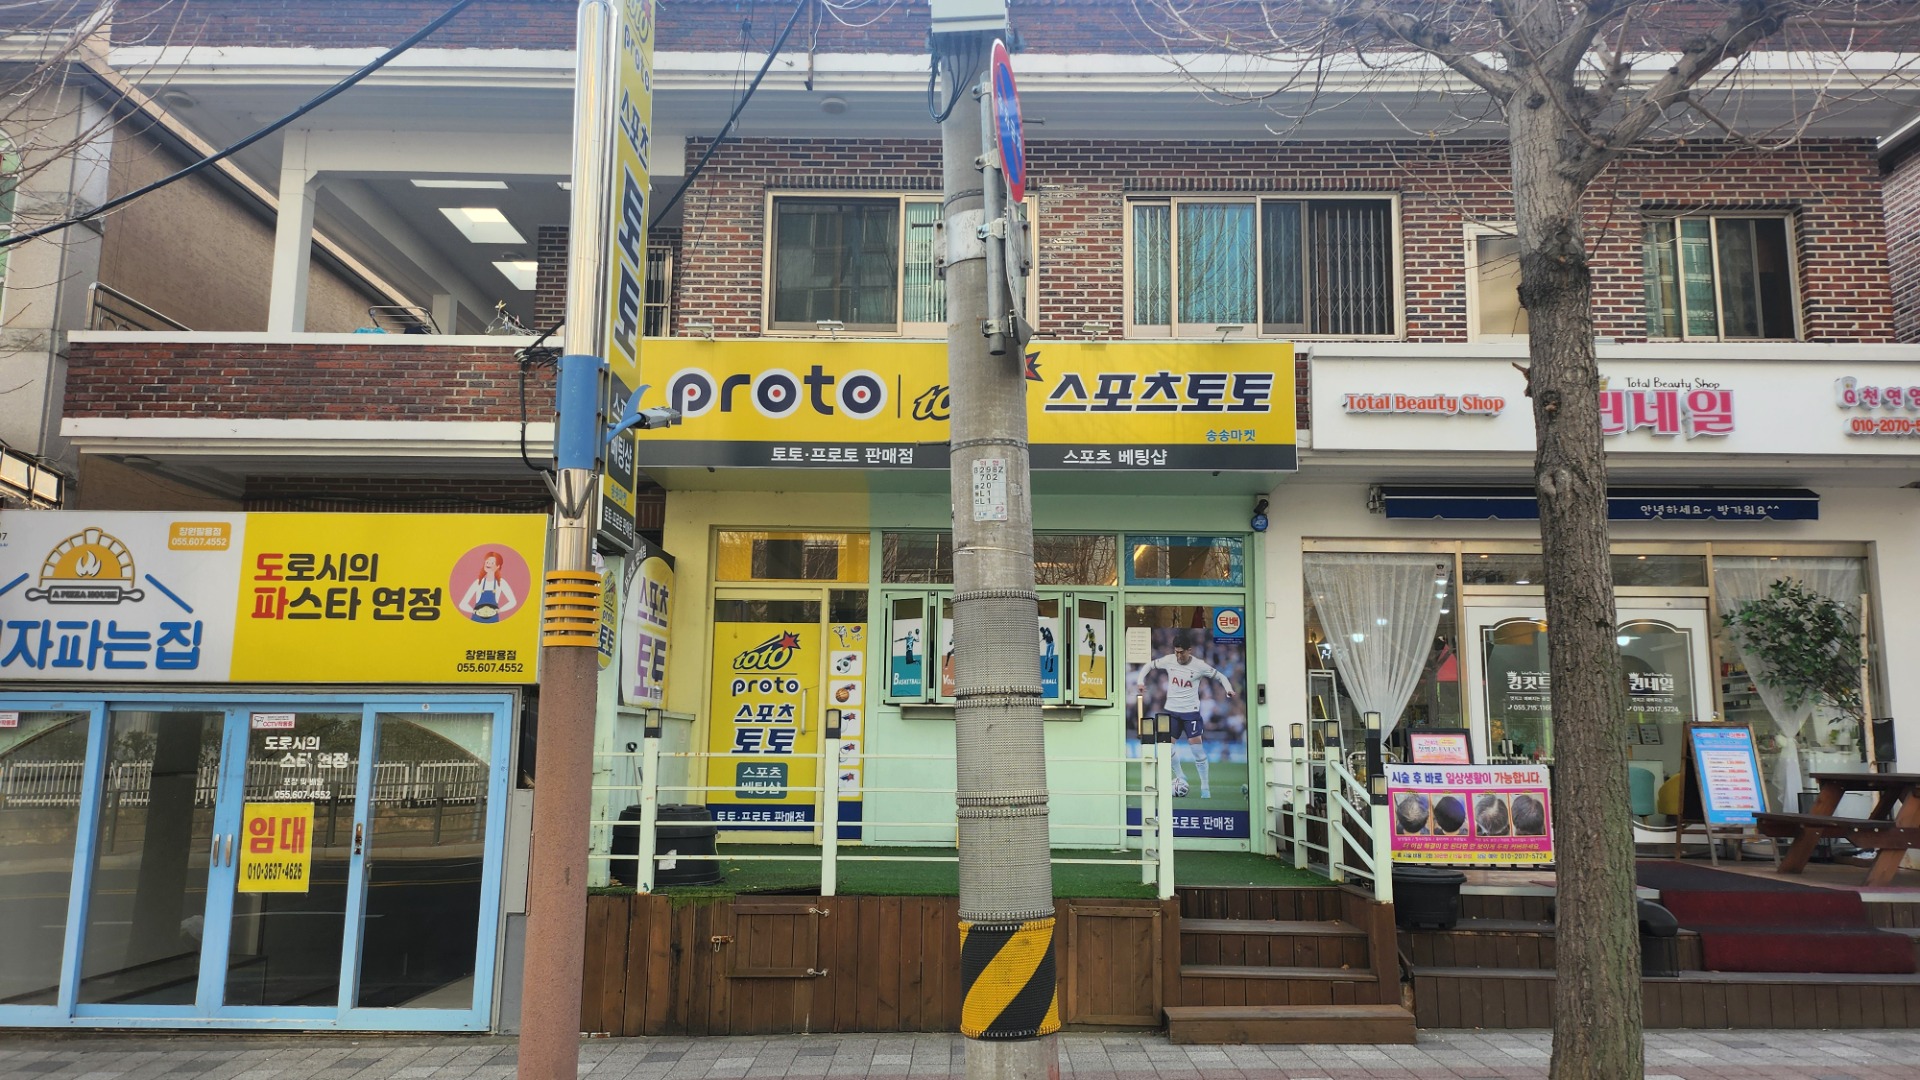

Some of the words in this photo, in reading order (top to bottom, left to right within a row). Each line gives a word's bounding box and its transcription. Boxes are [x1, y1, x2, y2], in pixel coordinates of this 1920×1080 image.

[624, 24, 650, 92] proto
[619, 88, 649, 170] 스포츠
[613, 164, 645, 364] 토토
[1044, 371, 1275, 413] 스포츠토토
[1625, 376, 1650, 388] Total
[1653, 377, 1692, 392] Beauty
[1694, 377, 1720, 392] Shop
[668, 364, 887, 425] proto
[1346, 394, 1391, 411] Total
[1395, 394, 1458, 412] Beauty
[1462, 394, 1505, 412] Shop
[1205, 429, 1256, 442] 송송마켓
[610, 438, 633, 476] 베팅샵
[771, 447, 859, 462] 토토·프로토
[865, 447, 914, 465] 판매점
[1063, 449, 1112, 465] 스포츠
[1118, 449, 1168, 466] 베팅샵
[980, 473, 998, 481] 702
[1640, 504, 1712, 516] 안녕하세요~
[1717, 504, 1780, 516] 방가워요^^
[171, 537, 227, 546] 055.607.4552
[253, 552, 379, 583] 도로시의
[52, 590, 60, 599] A
[60, 590, 87, 599] PIZZA
[87, 590, 118, 599] HOUSE
[637, 576, 669, 628] 스포츠
[251, 586, 362, 621] 파스타
[372, 586, 442, 621] 연정
[1218, 616, 1239, 627] 담배
[0, 618, 204, 671] 자파는집
[465, 649, 517, 661] 창원팔용점
[732, 642, 794, 671] toto
[456, 662, 524, 673] 055.607.4552
[633, 632, 668, 698] 토토
[732, 676, 800, 697] proto
[1171, 676, 1193, 689] AIA
[734, 703, 795, 724] 스포츠
[1190, 719, 1198, 731] 7
[264, 735, 320, 751] 도로시의
[731, 728, 797, 755] 토토
[317, 752, 349, 769] 연정
[742, 766, 782, 779] 스포츠
[1392, 771, 1410, 784] 시술
[1412, 771, 1422, 784] 후
[1424, 772, 1444, 784] 바로
[1445, 771, 1492, 785] 일상생활이
[1494, 771, 1542, 784] 가능합니다.
[274, 790, 331, 800] 055.607.4552
[741, 780, 782, 795] 베팅샵
[774, 810, 806, 822] 판매점
[1202, 816, 1235, 831] 판매점
[249, 816, 307, 854] 임대
[1500, 852, 1547, 860] 010-2017-5724
